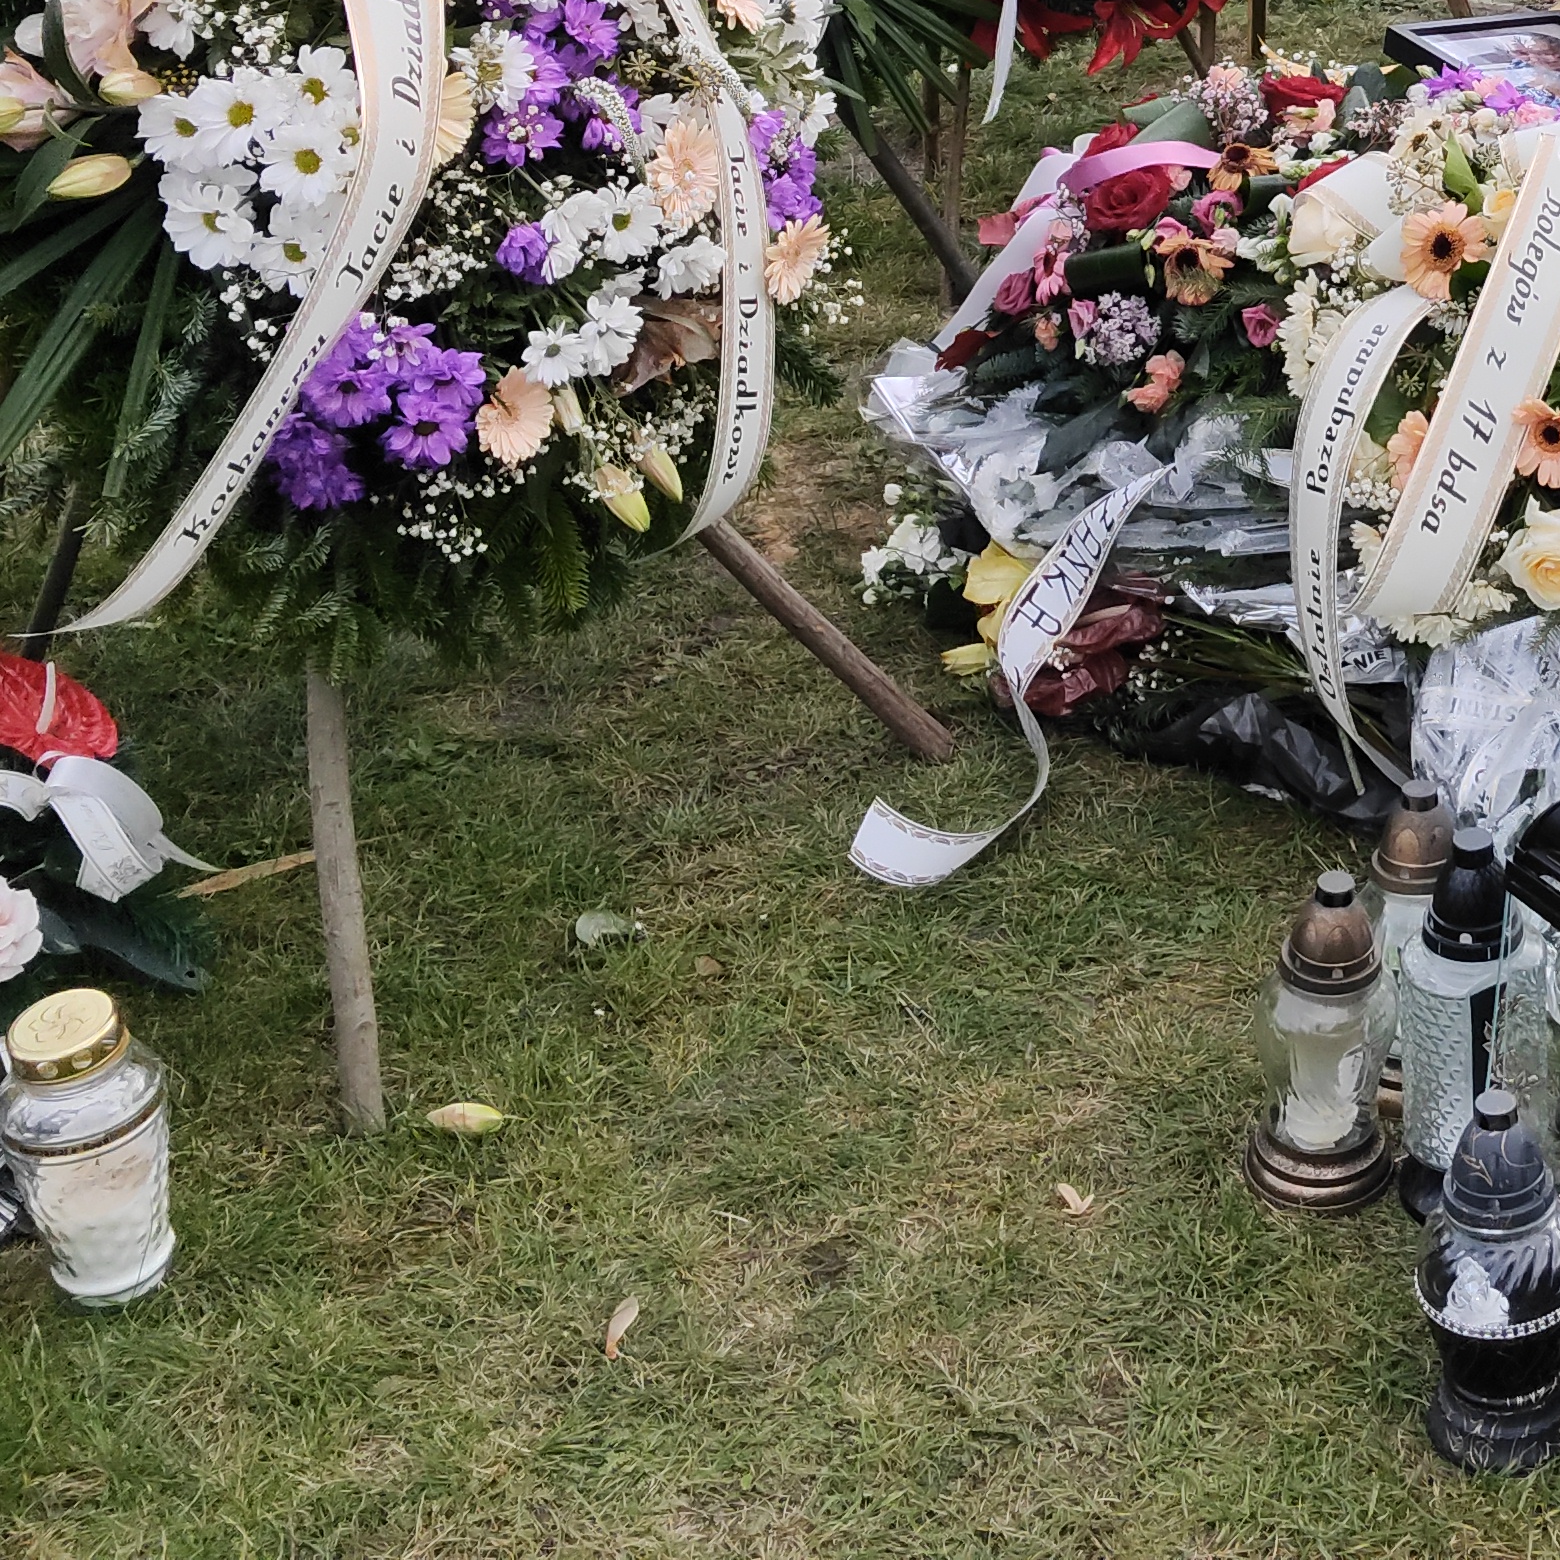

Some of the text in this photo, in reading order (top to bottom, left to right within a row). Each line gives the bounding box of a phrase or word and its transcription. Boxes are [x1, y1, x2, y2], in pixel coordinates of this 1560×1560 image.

[176, 331, 330, 551] Kochanemu
[724, 293, 760, 486] Dziadkowi
[1304, 320, 1390, 703] Ostatnie Pożegnanie
